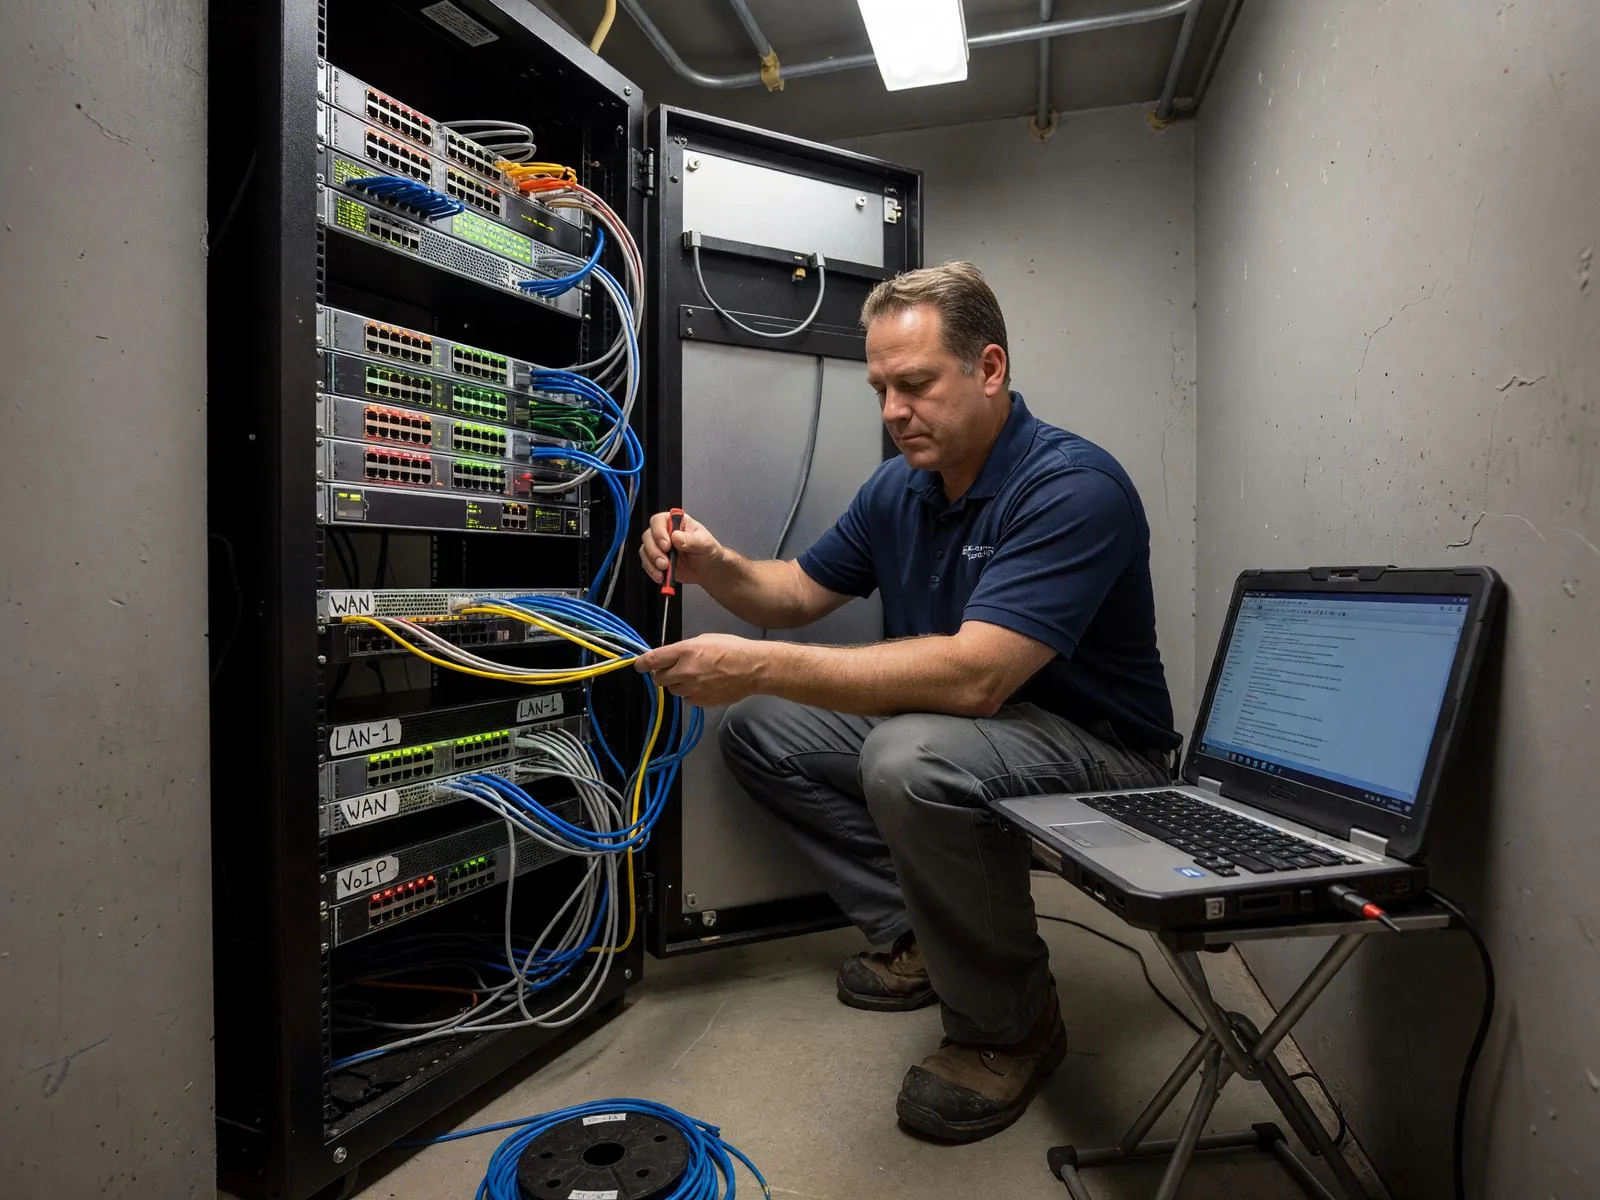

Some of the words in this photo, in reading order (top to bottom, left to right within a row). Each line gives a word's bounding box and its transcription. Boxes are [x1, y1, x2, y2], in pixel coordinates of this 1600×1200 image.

[331, 594, 369, 614] WAN
[520, 695, 557, 718] LAN-1
[336, 722, 394, 751] LAN-1
[347, 793, 386, 820] WAN
[342, 860, 387, 891] VoIP
